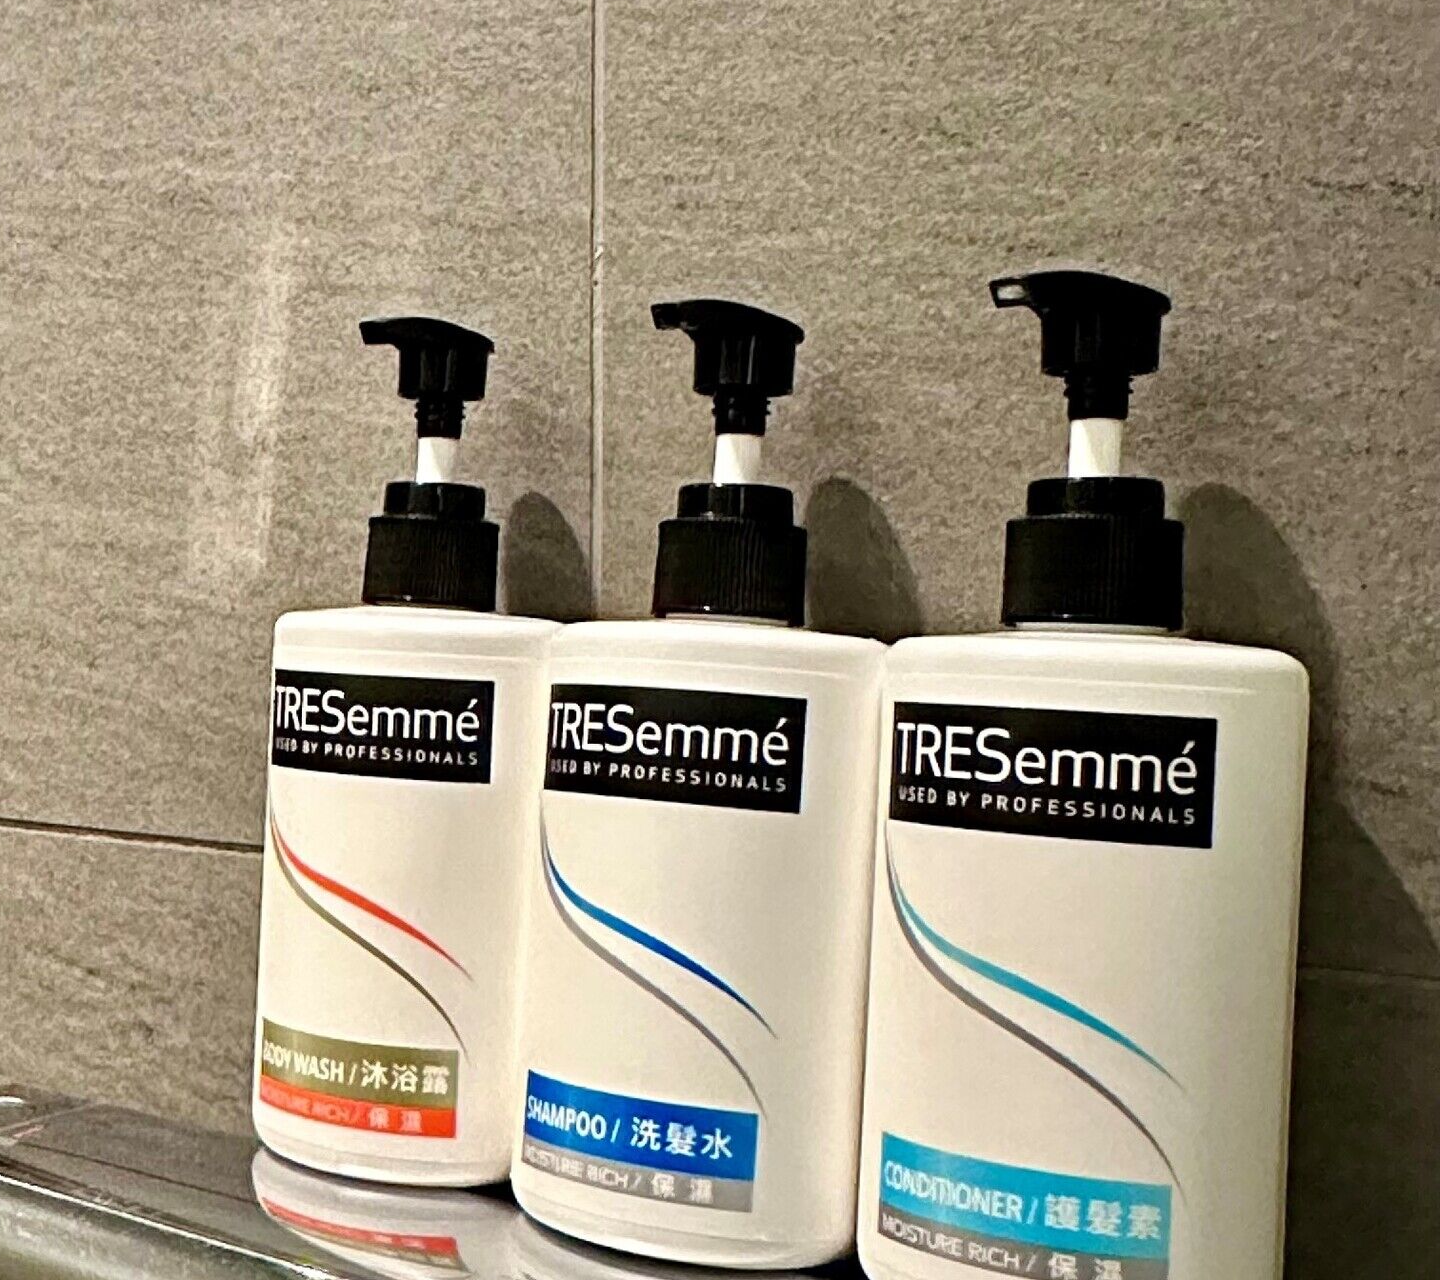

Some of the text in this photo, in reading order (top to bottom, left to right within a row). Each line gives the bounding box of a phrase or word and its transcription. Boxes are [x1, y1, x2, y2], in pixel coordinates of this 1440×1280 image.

[276, 685, 480, 743] TRESemmé
[551, 701, 790, 766] TRESemmé
[324, 742, 478, 766] PROFESSIONALS
[583, 760, 601, 776] BY
[609, 762, 787, 793] PROFESSIONALS
[896, 721, 1198, 797] TRESemmé
[898, 785, 1197, 826] USED BY PROFESSIONALS
[292, 1050, 345, 1085] WASH
[360, 1058, 451, 1096] 沐浴露
[527, 1094, 607, 1141] SHAMPOO
[630, 1115, 734, 1160] 洗髮水
[883, 1159, 1024, 1223] CONDITIONER
[881, 1211, 964, 1258] MOISTURE
[967, 1241, 1021, 1271] RICH
